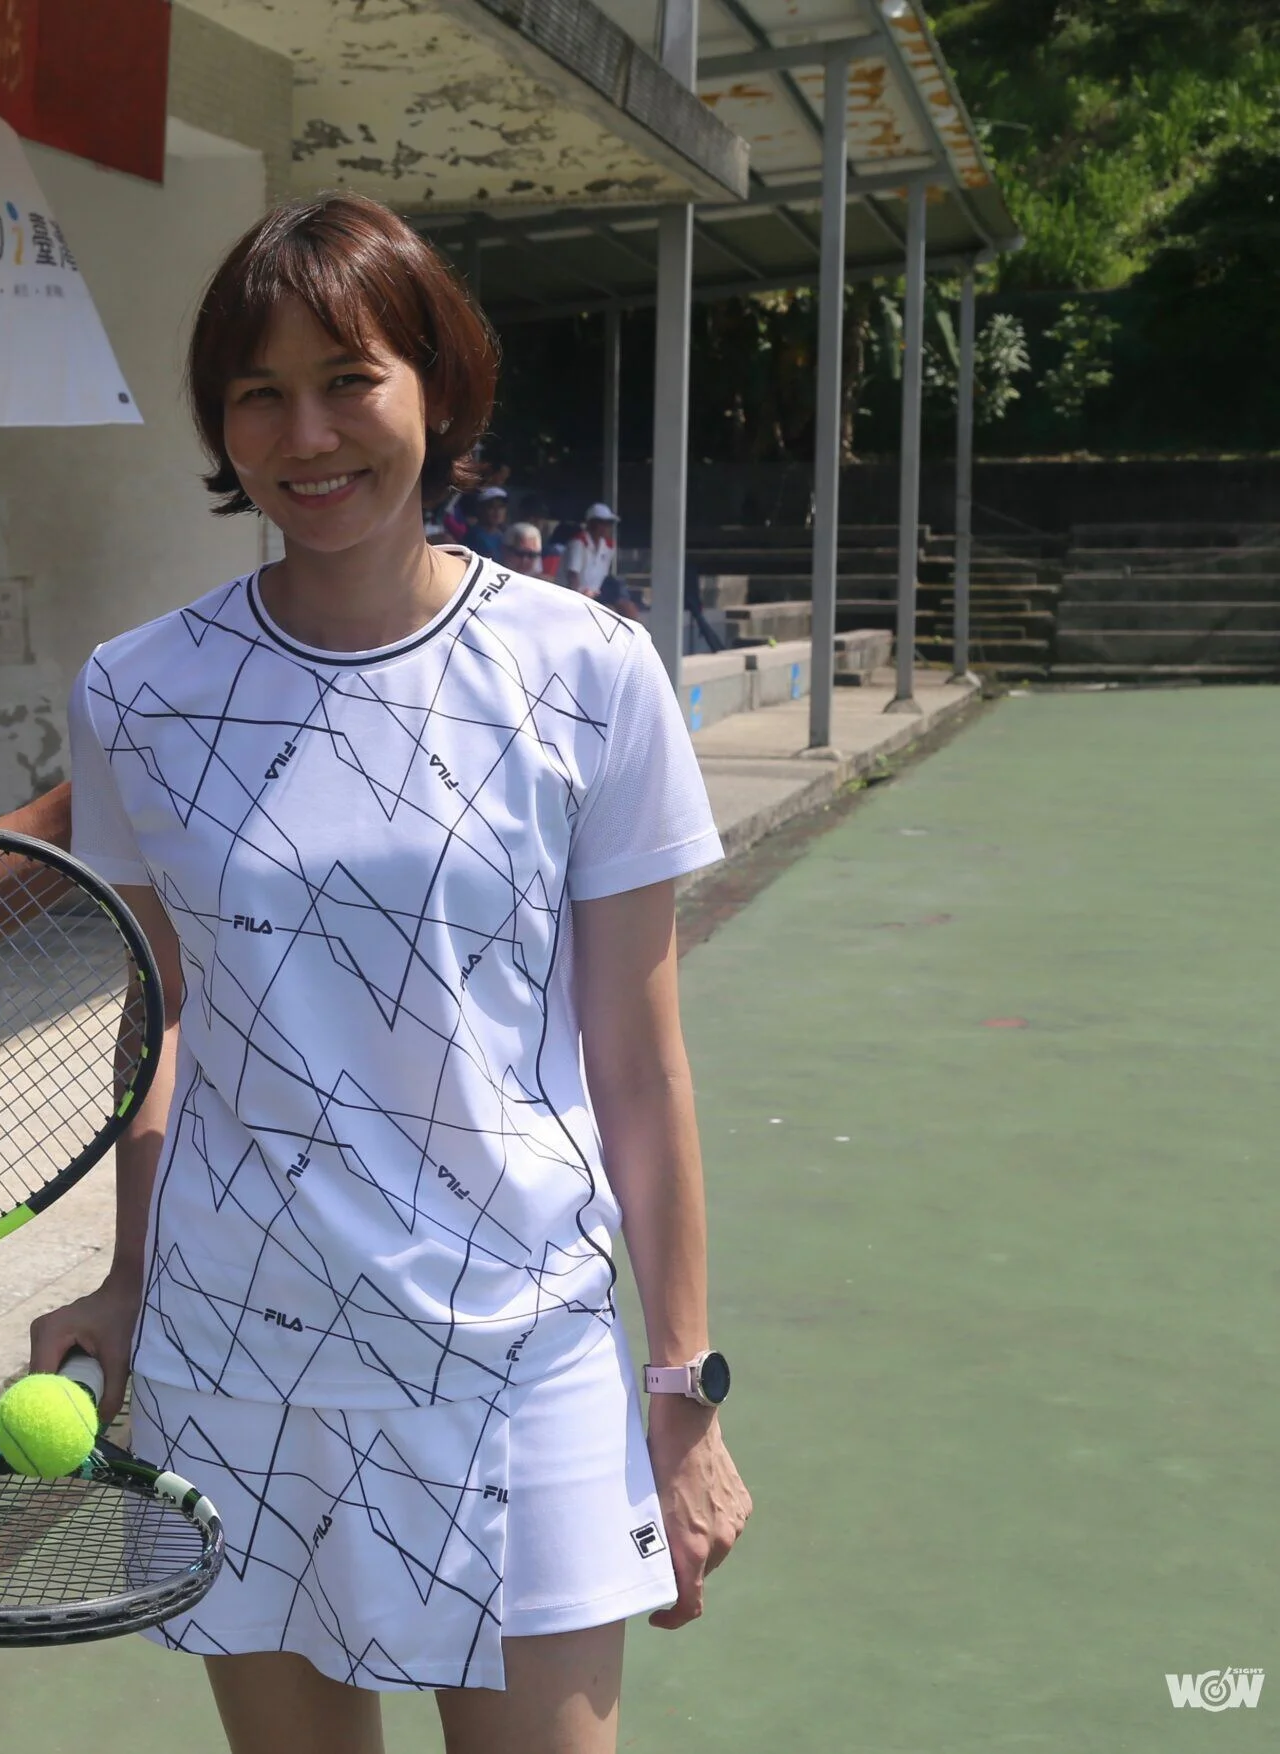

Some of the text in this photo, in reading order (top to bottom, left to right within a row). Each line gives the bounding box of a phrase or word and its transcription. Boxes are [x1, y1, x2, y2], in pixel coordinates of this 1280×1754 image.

[479, 573, 511, 602] FILA
[264, 741, 297, 779] FILA
[429, 754, 459, 791] FILA
[233, 914, 273, 935] FILA
[460, 954, 482, 992] FILA
[438, 1165, 470, 1200] FILA
[264, 1308, 303, 1332] FILA
[313, 1514, 333, 1549] FILA
